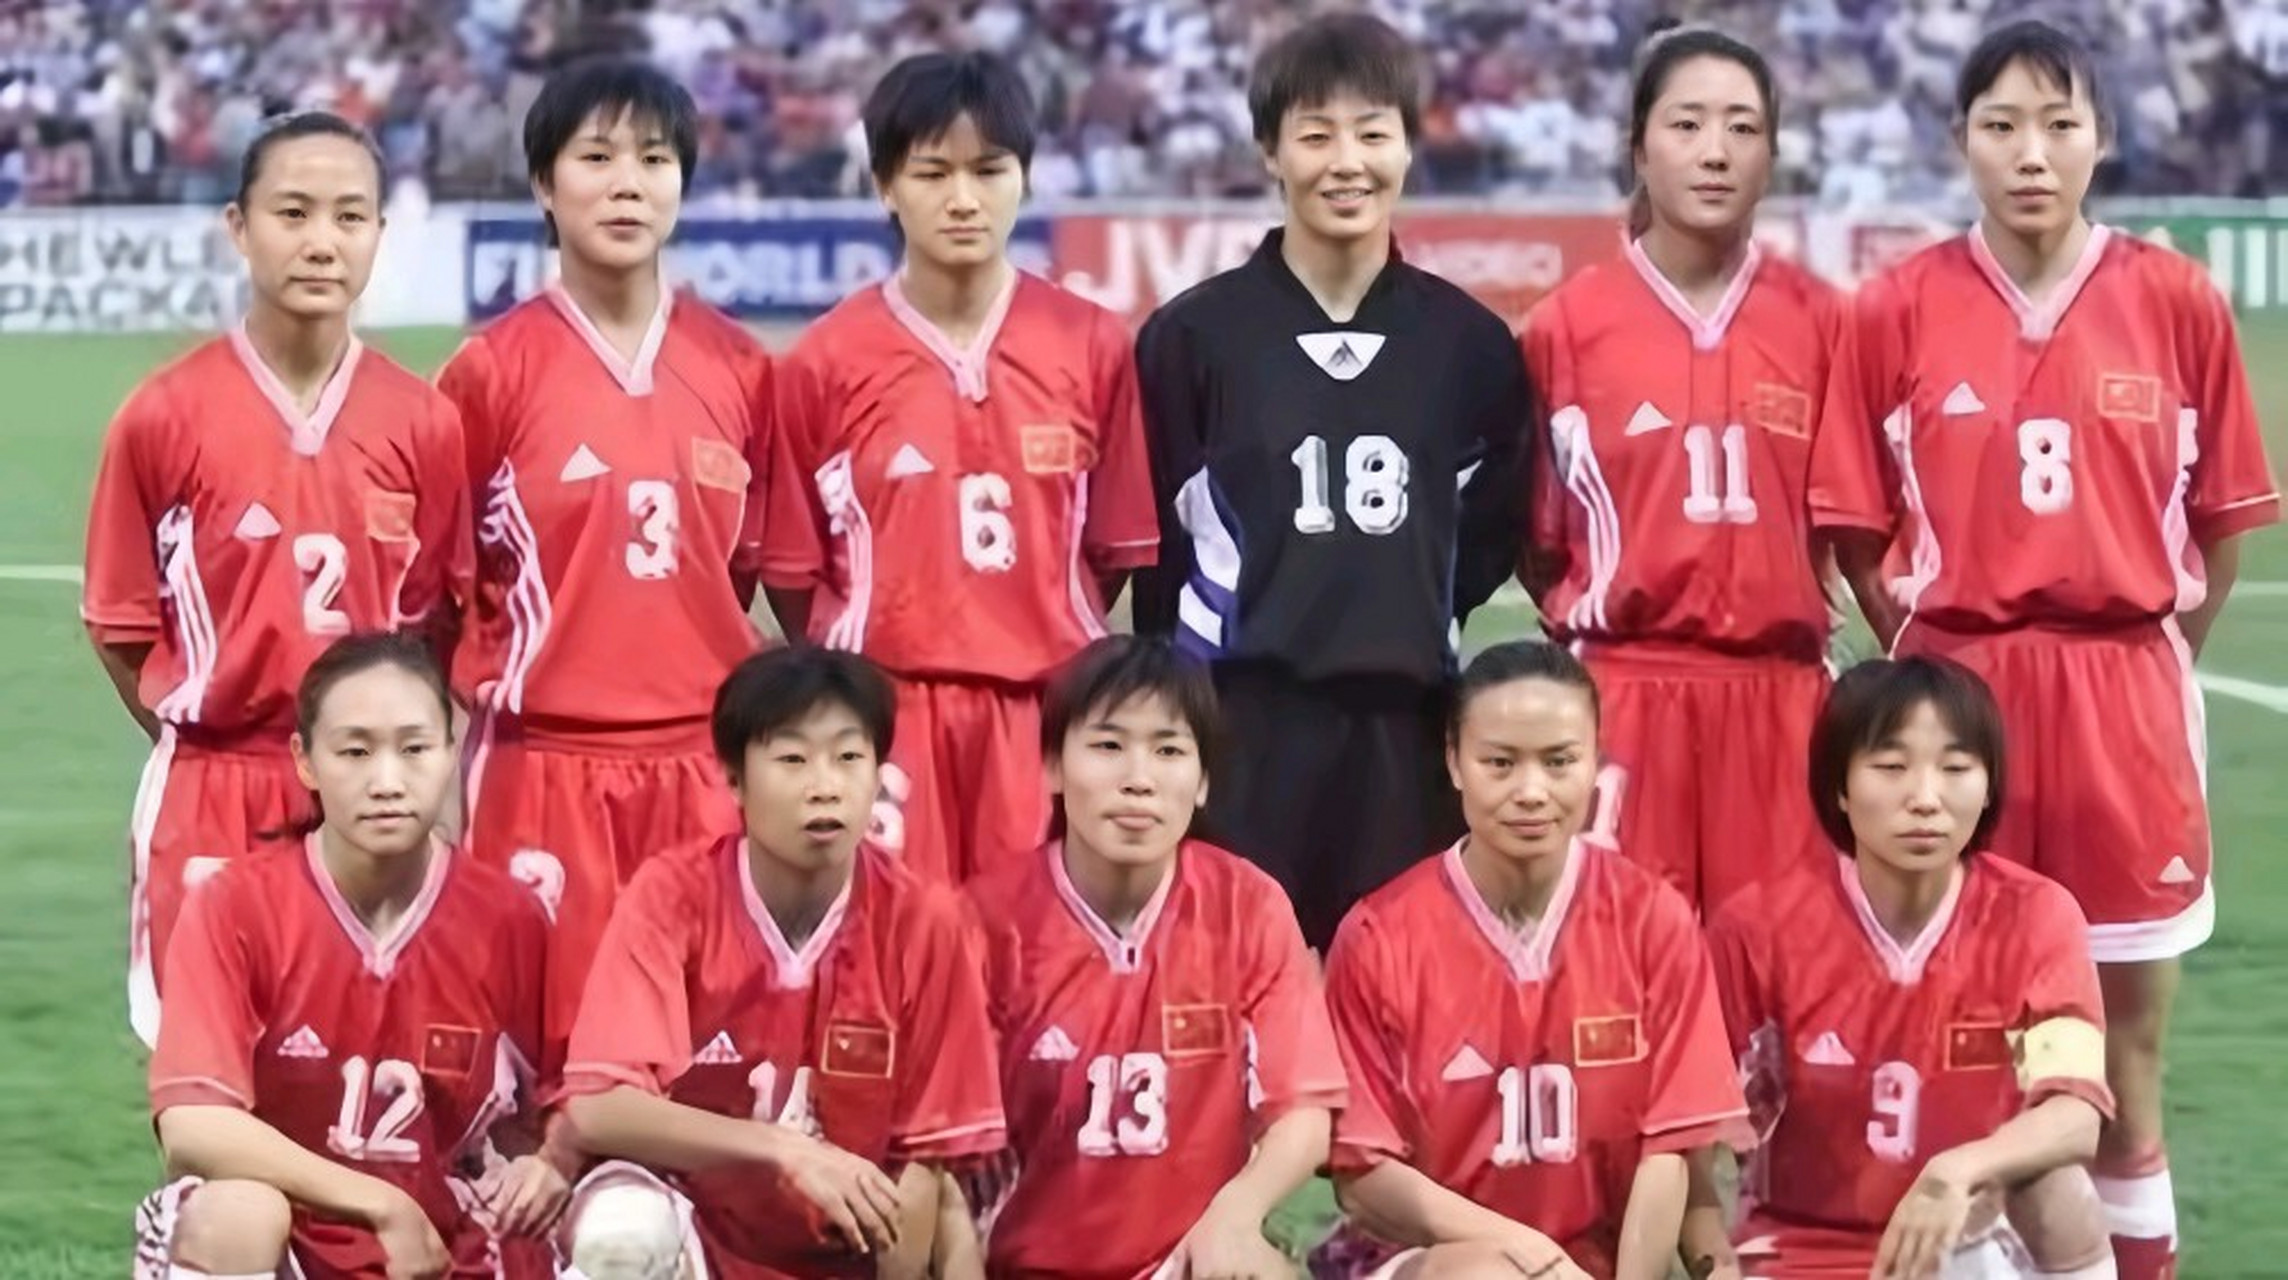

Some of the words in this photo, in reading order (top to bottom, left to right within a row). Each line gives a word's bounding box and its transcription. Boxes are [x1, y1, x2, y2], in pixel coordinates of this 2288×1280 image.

[1290, 434, 1411, 535] 18
[1682, 423, 1759, 524] 11
[2016, 417, 2074, 515] 8
[625, 479, 681, 580] 3
[957, 472, 1018, 573] 6
[292, 531, 352, 637] 2
[326, 1054, 426, 1163] 12
[1076, 1052, 1170, 1157] 13
[1490, 1062, 1579, 1168] 10
[1866, 1060, 1922, 1163] 9
